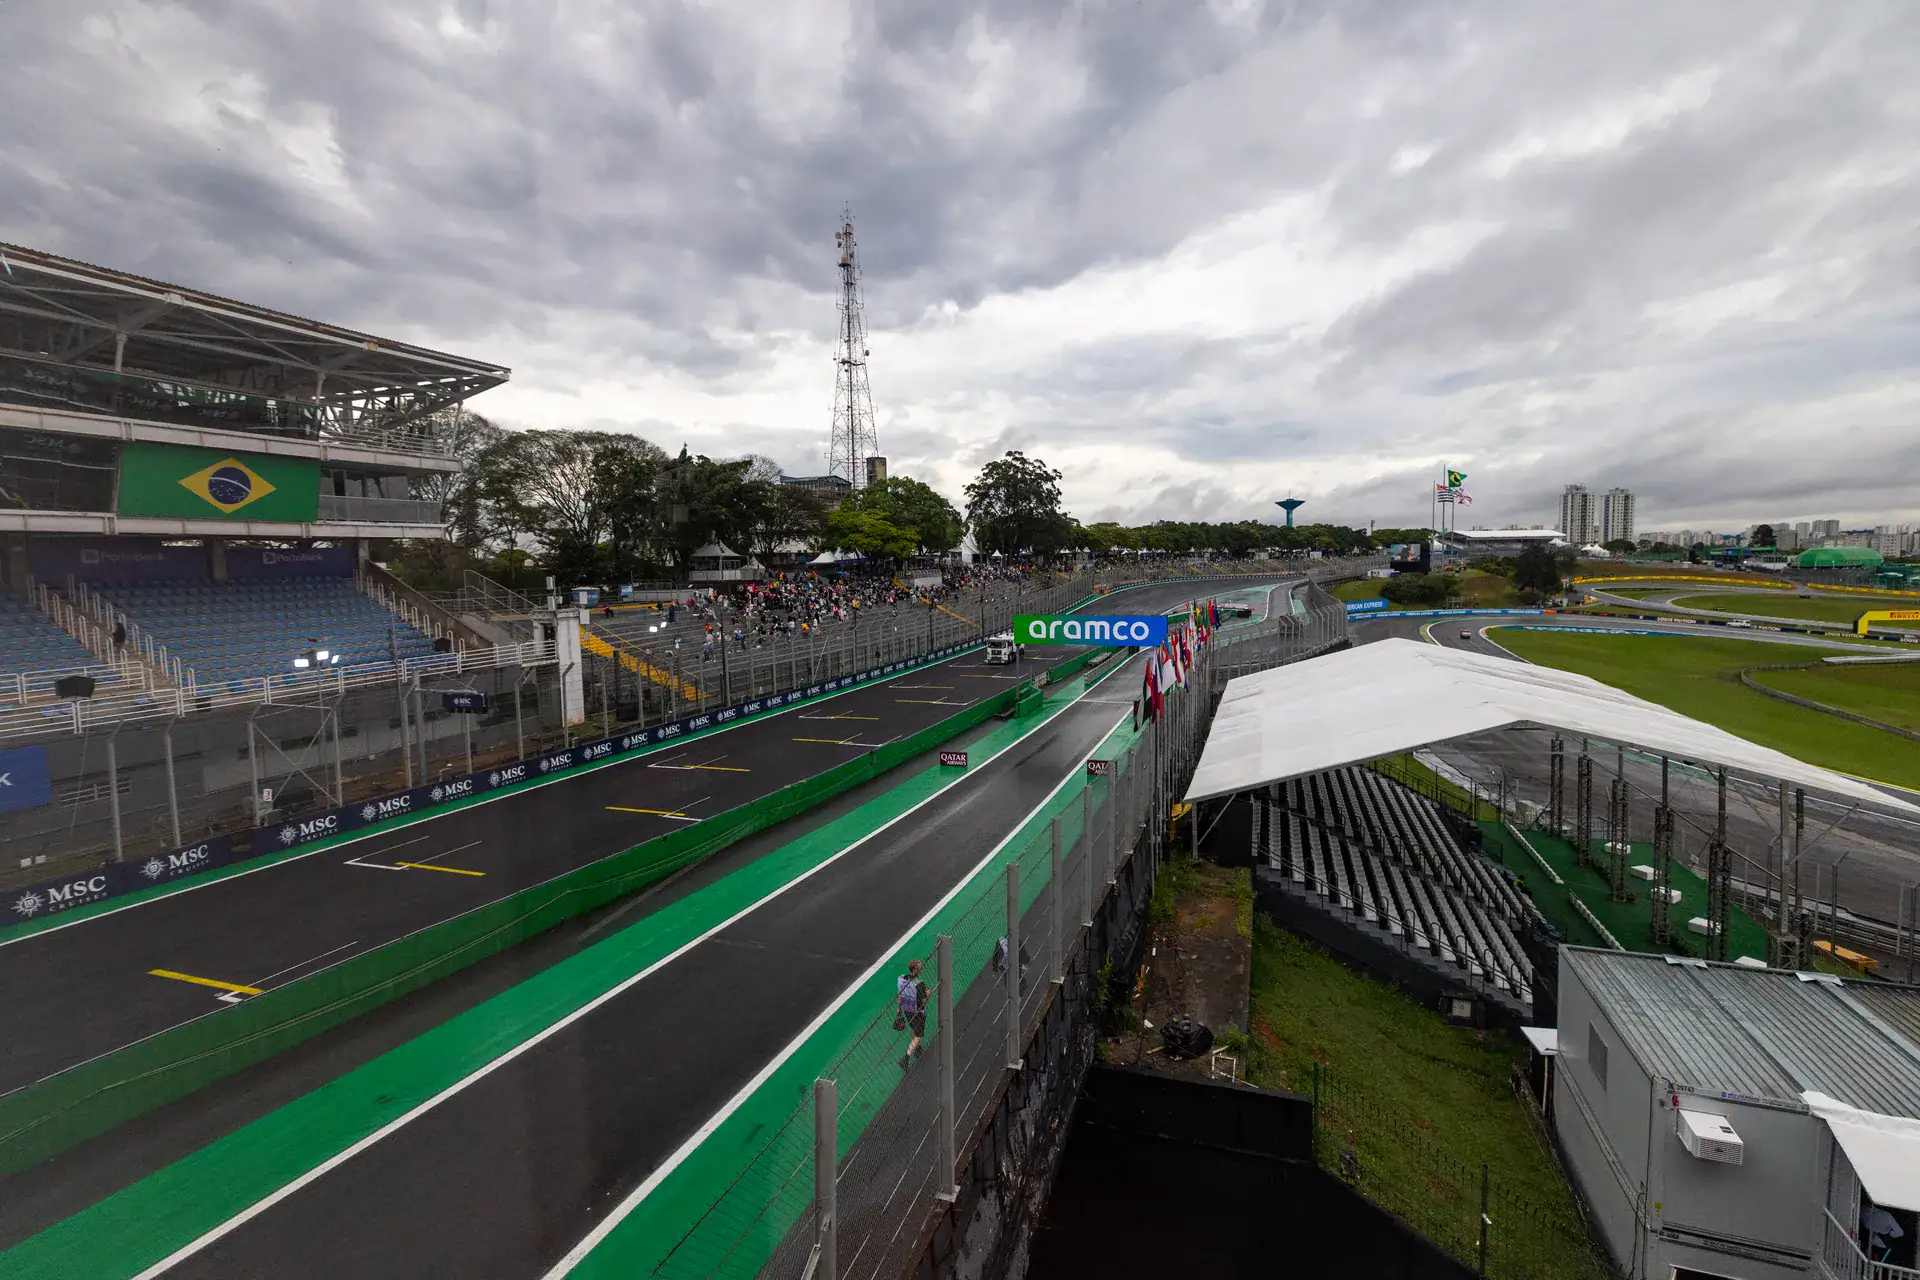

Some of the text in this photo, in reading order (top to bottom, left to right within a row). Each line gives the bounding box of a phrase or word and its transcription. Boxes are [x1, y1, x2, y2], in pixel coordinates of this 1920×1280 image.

[1028, 620, 1150, 641] aramco
[665, 724, 681, 736] MSC
[630, 732, 648, 746] MSC
[592, 742, 612, 756] MSC
[940, 753, 966, 762] QATAR
[550, 753, 572, 768] MSC
[501, 765, 526, 781] MSC
[444, 779, 473, 797] MSC
[377, 795, 411, 814] MSC
[299, 815, 337, 837] MSC
[168, 844, 209, 870] MSC
[46, 875, 107, 905] MSC
